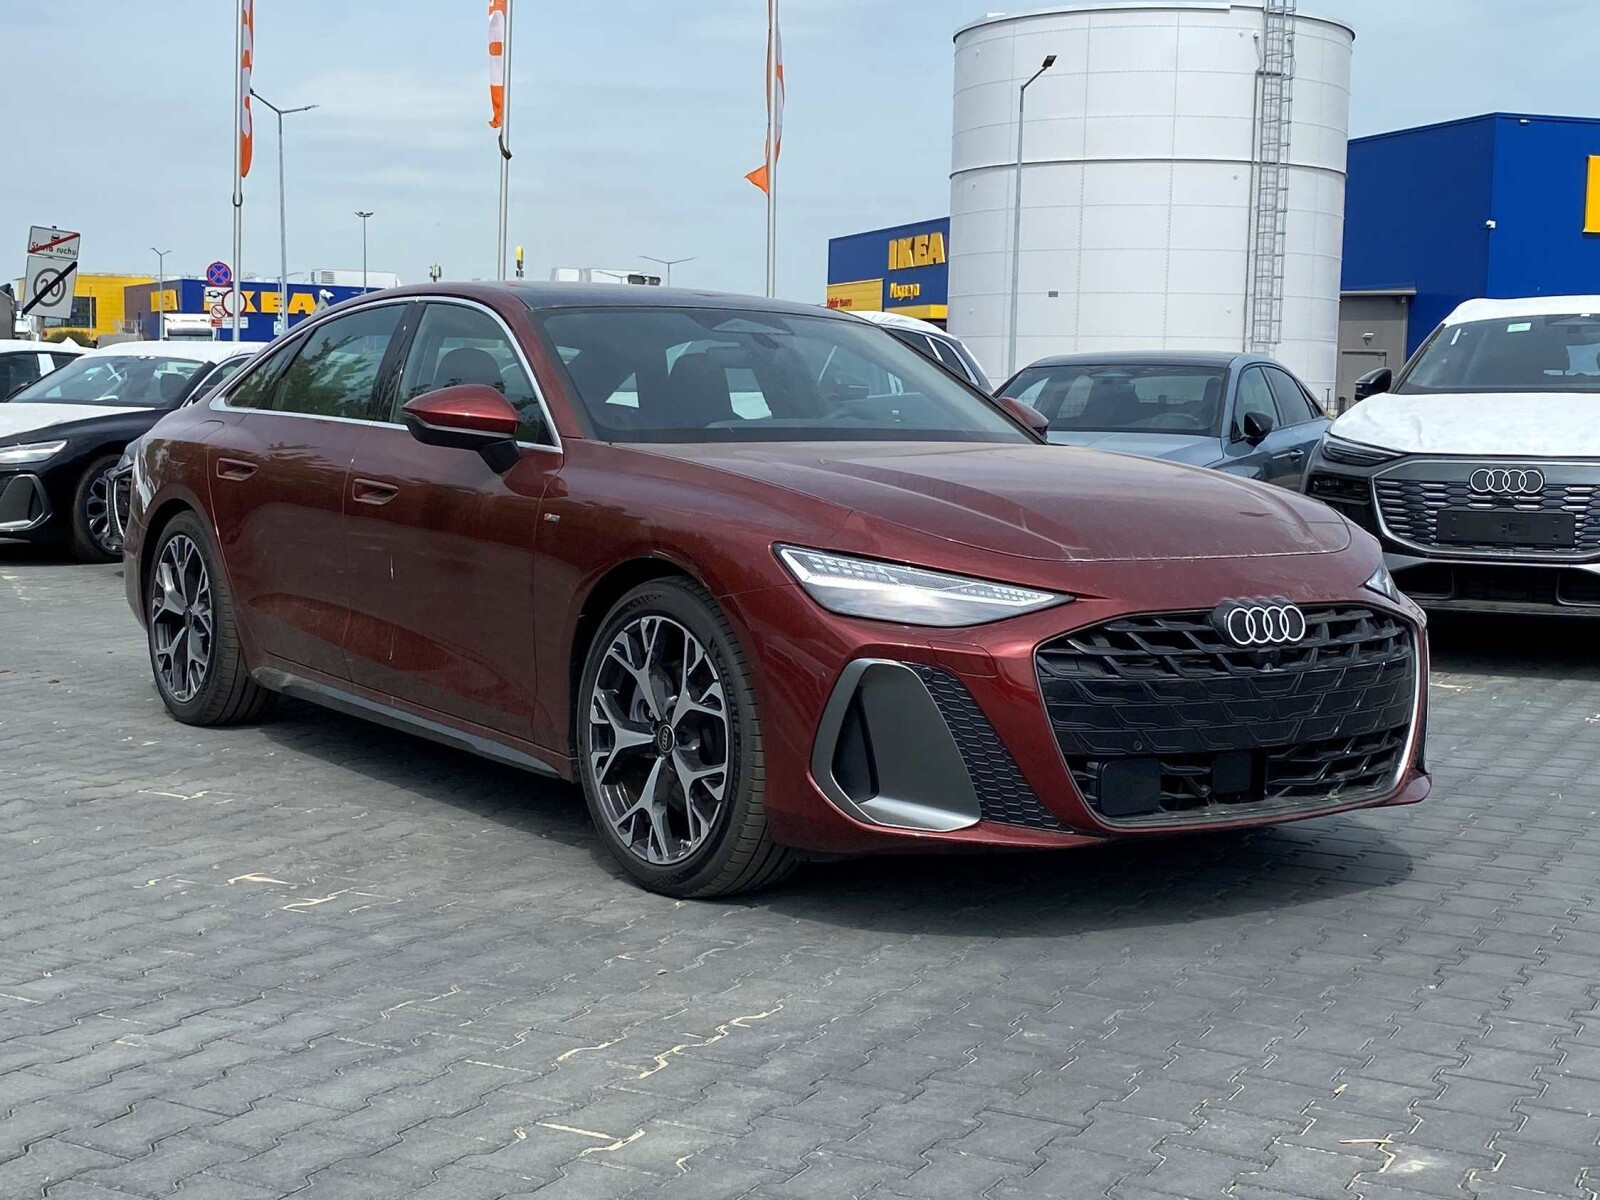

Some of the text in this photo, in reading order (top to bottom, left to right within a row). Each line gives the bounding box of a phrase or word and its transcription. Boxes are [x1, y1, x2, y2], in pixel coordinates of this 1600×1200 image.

[56, 247, 77, 255] ruchu
[889, 232, 945, 270] IKEA
[204, 290, 317, 314] KEA
